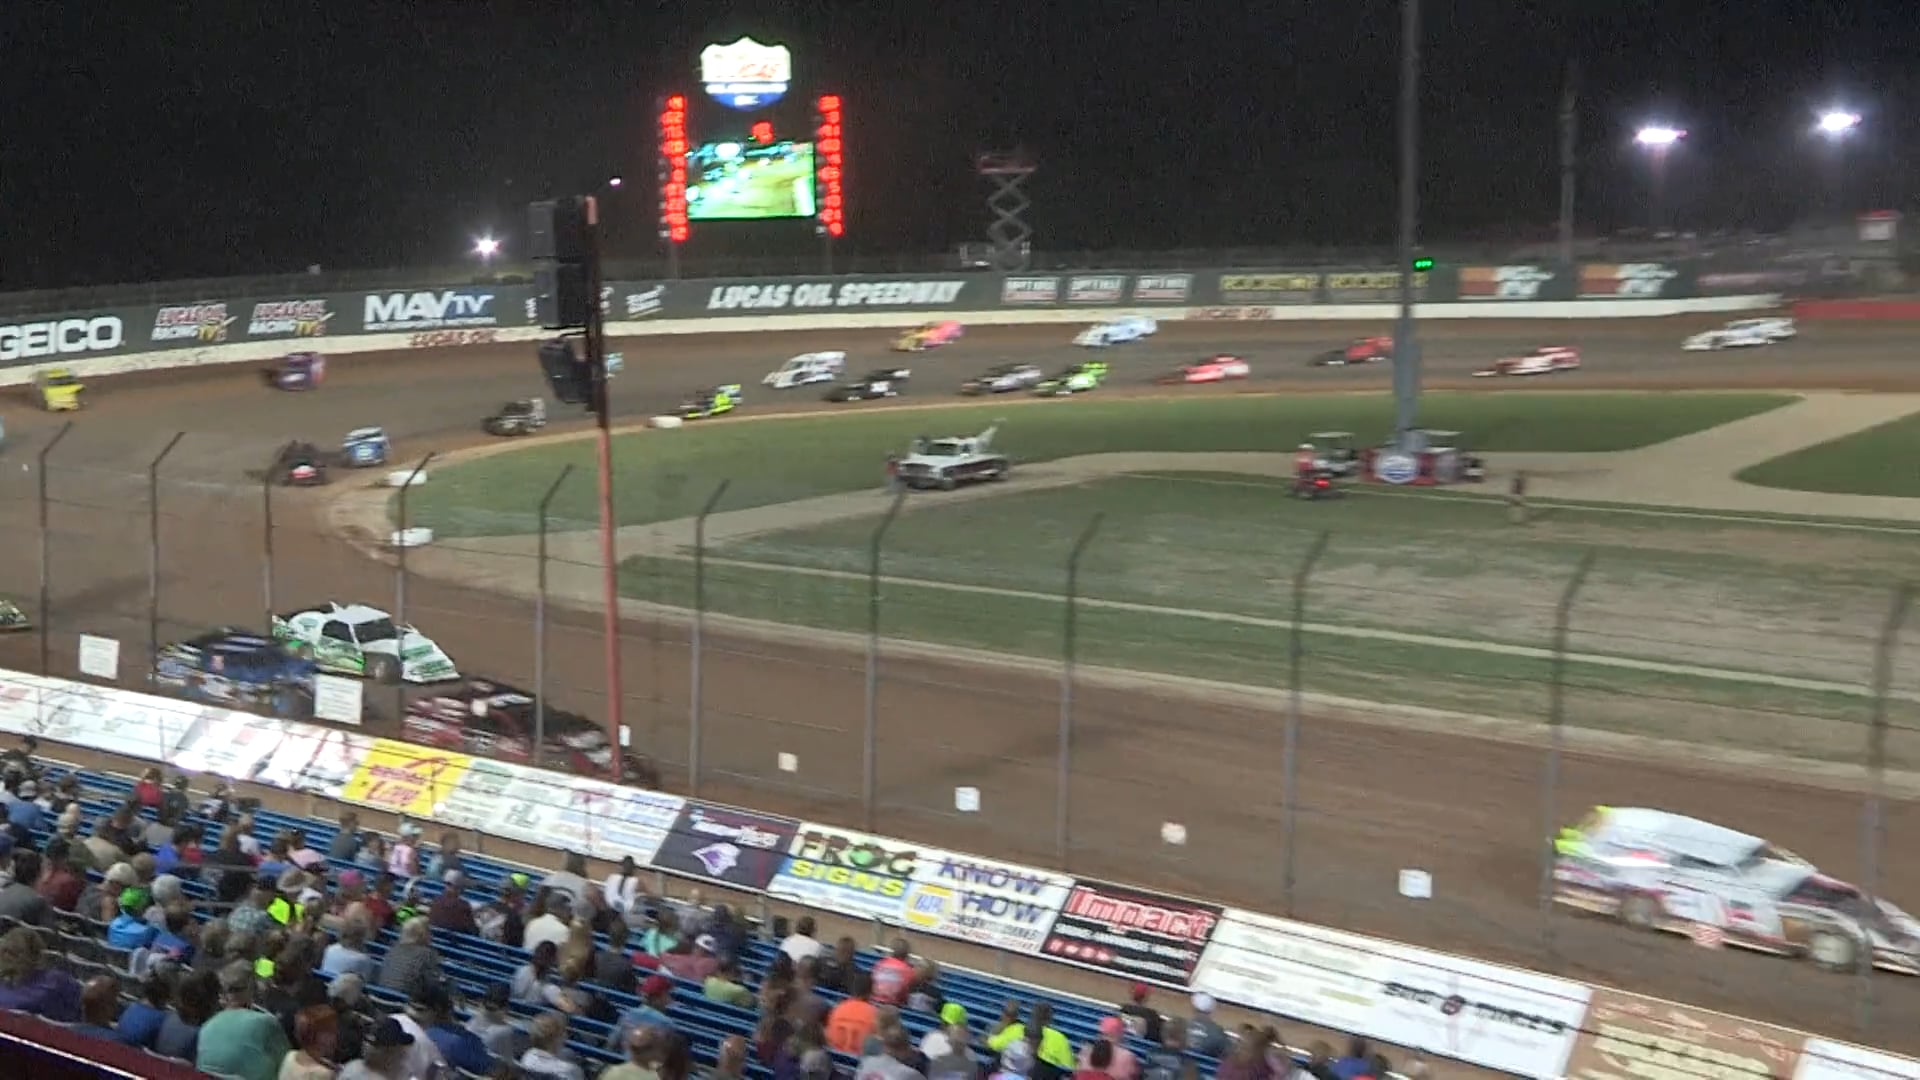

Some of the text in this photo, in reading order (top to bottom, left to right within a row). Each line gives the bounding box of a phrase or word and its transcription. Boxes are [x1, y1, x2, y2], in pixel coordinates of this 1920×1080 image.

[707, 281, 966, 309] LUCAS OIL SPEEDWAY
[0, 317, 122, 360] GEICO
[799, 830, 917, 876] FROG
[788, 859, 906, 897] SIGNS
[938, 857, 1046, 896] KNOW
[961, 890, 1043, 923] HOW
[1064, 886, 1217, 941] Impact
